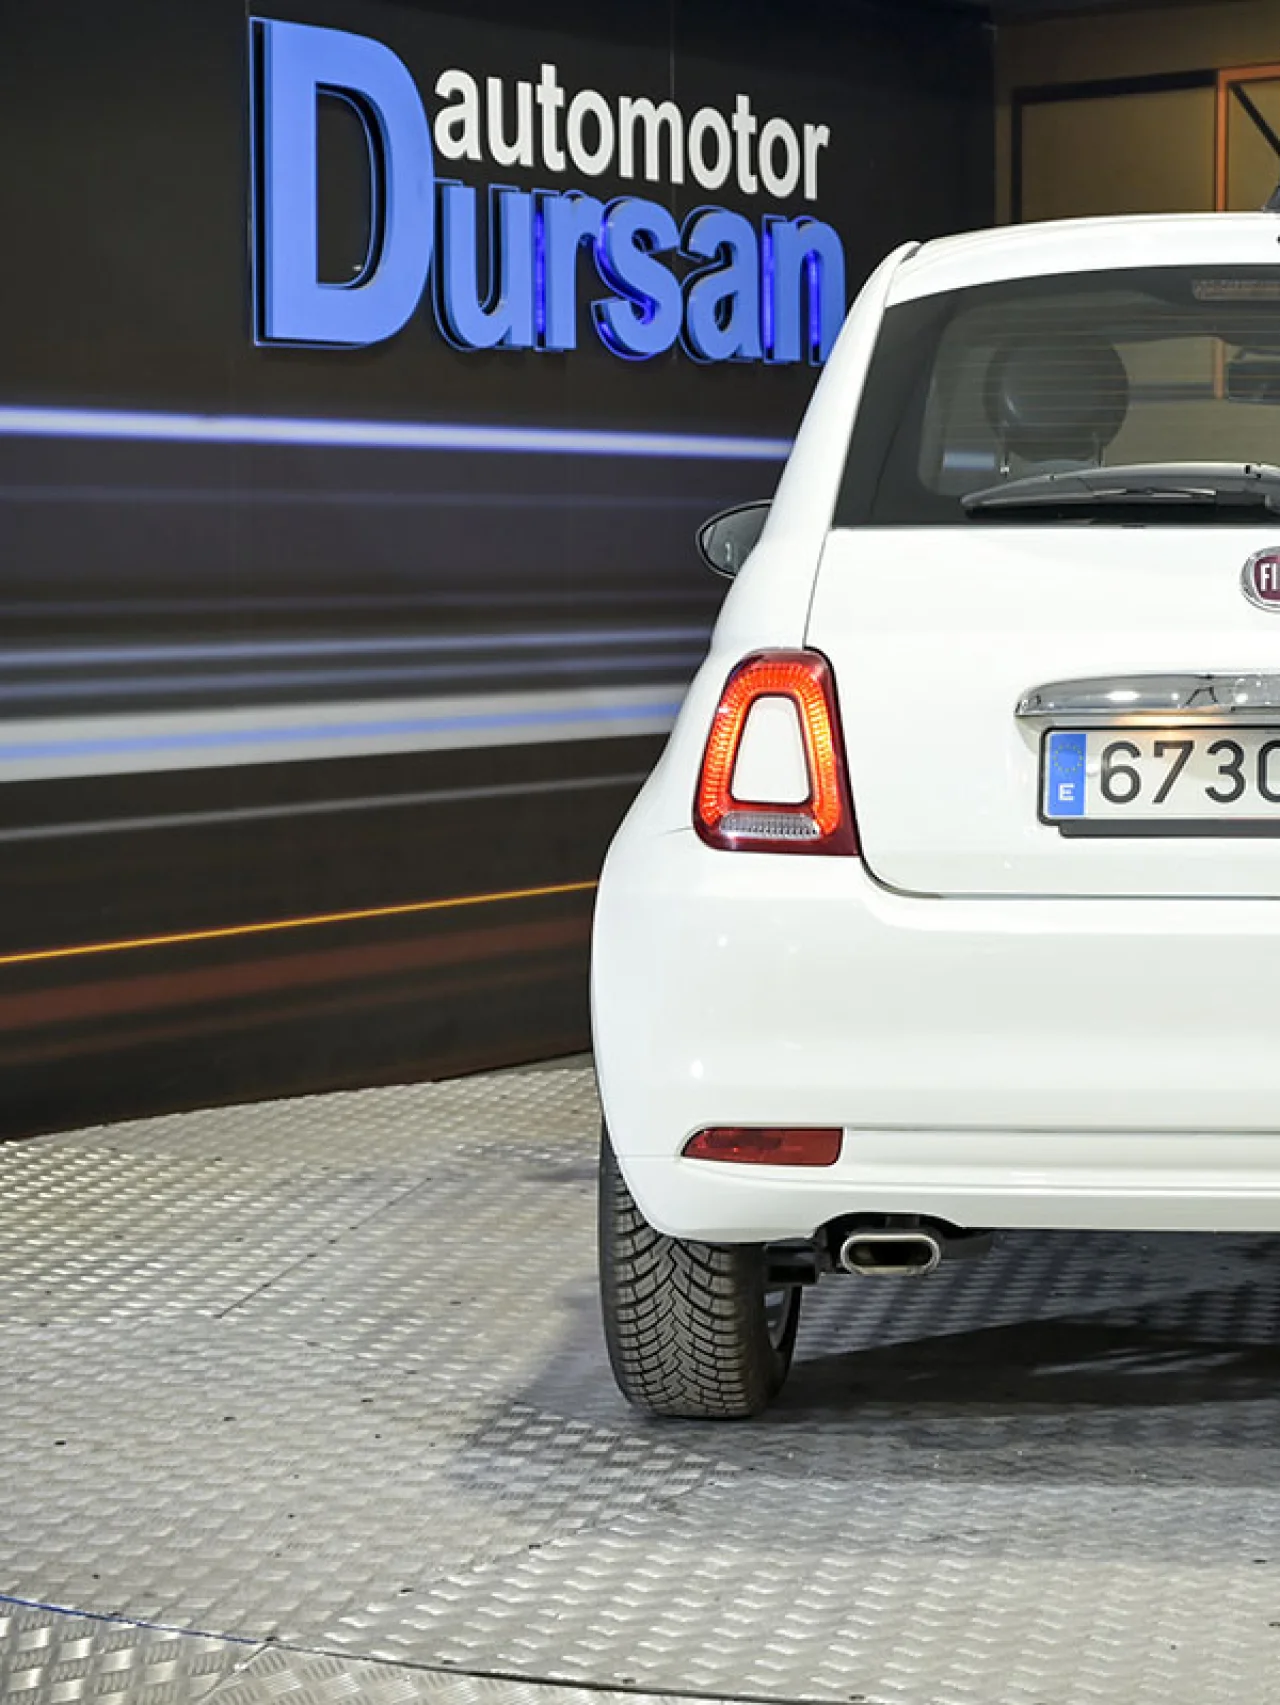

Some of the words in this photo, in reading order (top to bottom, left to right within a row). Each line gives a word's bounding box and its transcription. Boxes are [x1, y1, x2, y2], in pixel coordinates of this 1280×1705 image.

[250, 16, 847, 368] Dursan
[433, 63, 830, 200] automotor
[1058, 782, 1076, 801] E
